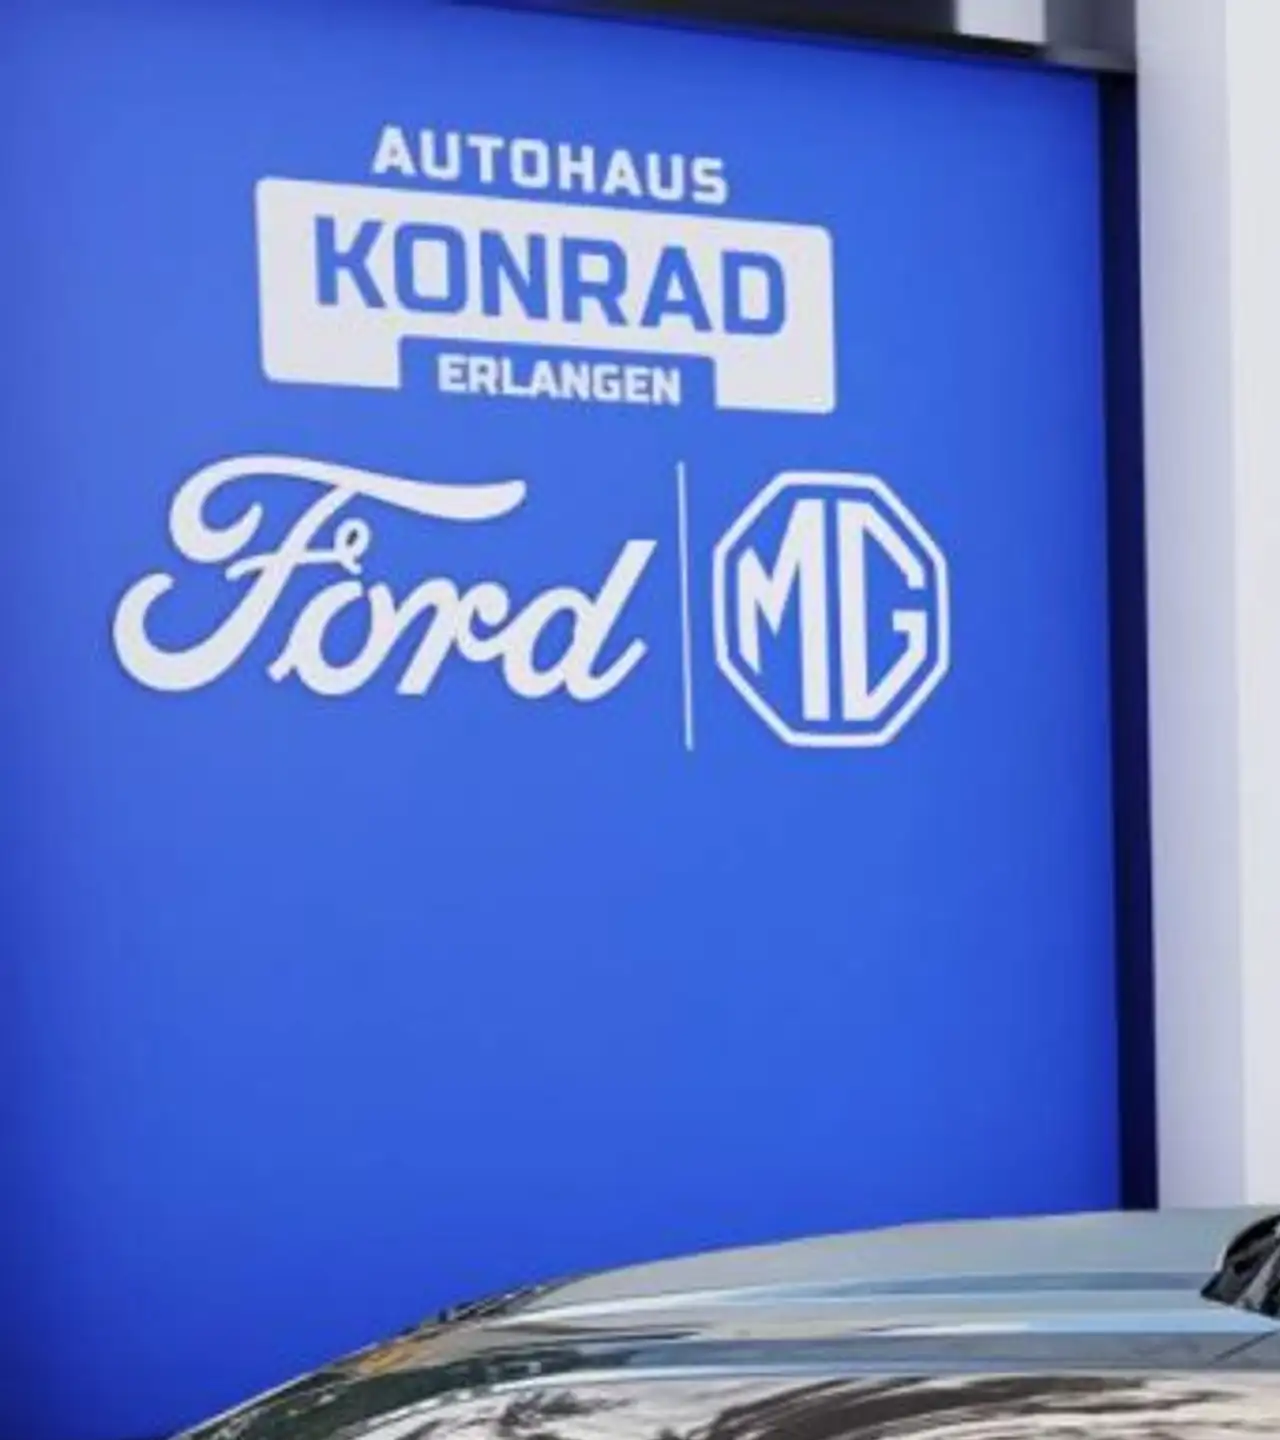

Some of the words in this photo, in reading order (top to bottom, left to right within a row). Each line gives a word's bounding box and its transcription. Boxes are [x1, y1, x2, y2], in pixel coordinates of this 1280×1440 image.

[372, 126, 728, 205] AUTOHAUS
[313, 214, 787, 337] KONRAD
[436, 353, 682, 405] ERLANGEN
[112, 455, 658, 701] Ford
[736, 498, 928, 722] MG
